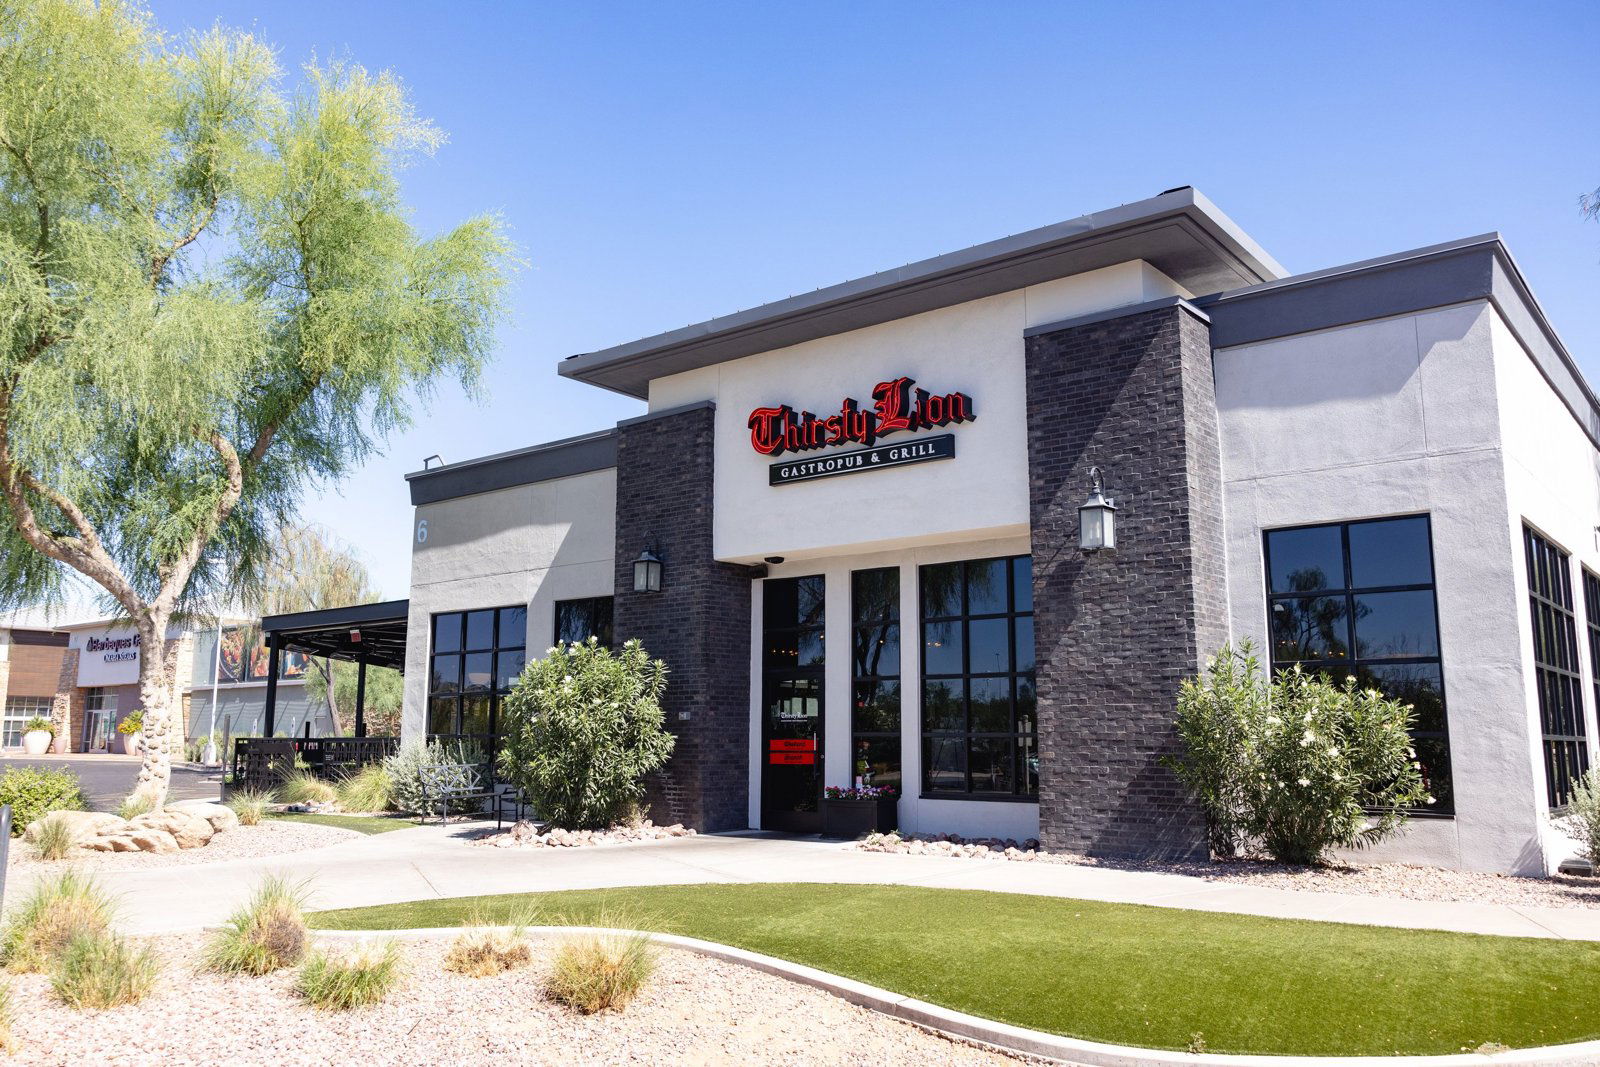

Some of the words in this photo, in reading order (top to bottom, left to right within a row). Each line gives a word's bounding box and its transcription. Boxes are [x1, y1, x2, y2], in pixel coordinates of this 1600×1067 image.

[748, 398, 876, 457] Thirsty
[872, 376, 976, 438] Lion
[780, 456, 863, 478] GASTROPUB
[871, 453, 881, 463] &
[889, 443, 936, 460] GRILL
[417, 519, 428, 543] 6
